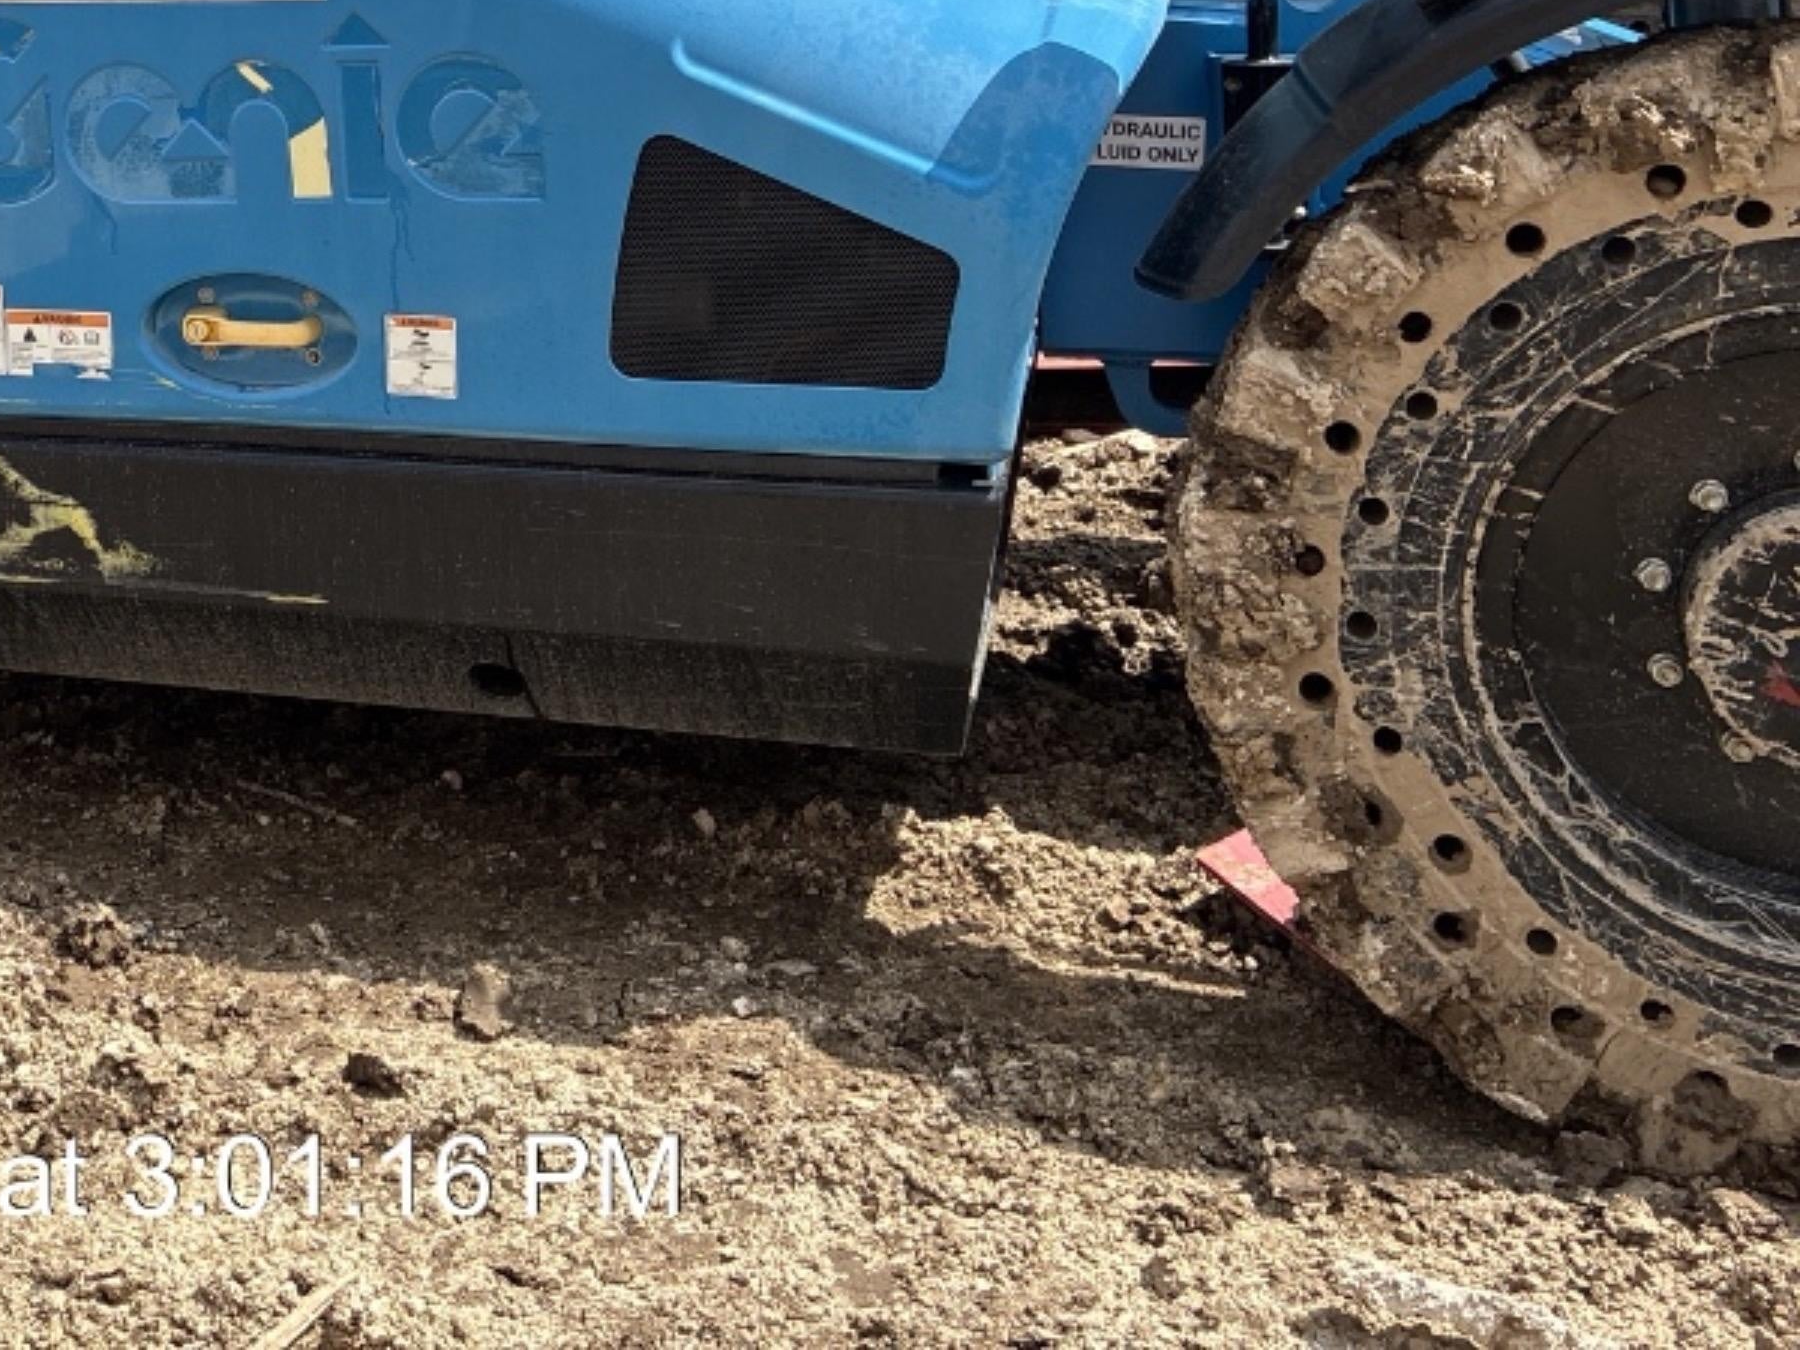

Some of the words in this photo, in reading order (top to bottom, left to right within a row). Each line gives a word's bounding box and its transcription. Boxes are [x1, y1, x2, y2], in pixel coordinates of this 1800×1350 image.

[1103, 121, 1201, 141] DRAULIC
[1097, 143, 1141, 160] LUID
[1148, 146, 1198, 162] ONLY
